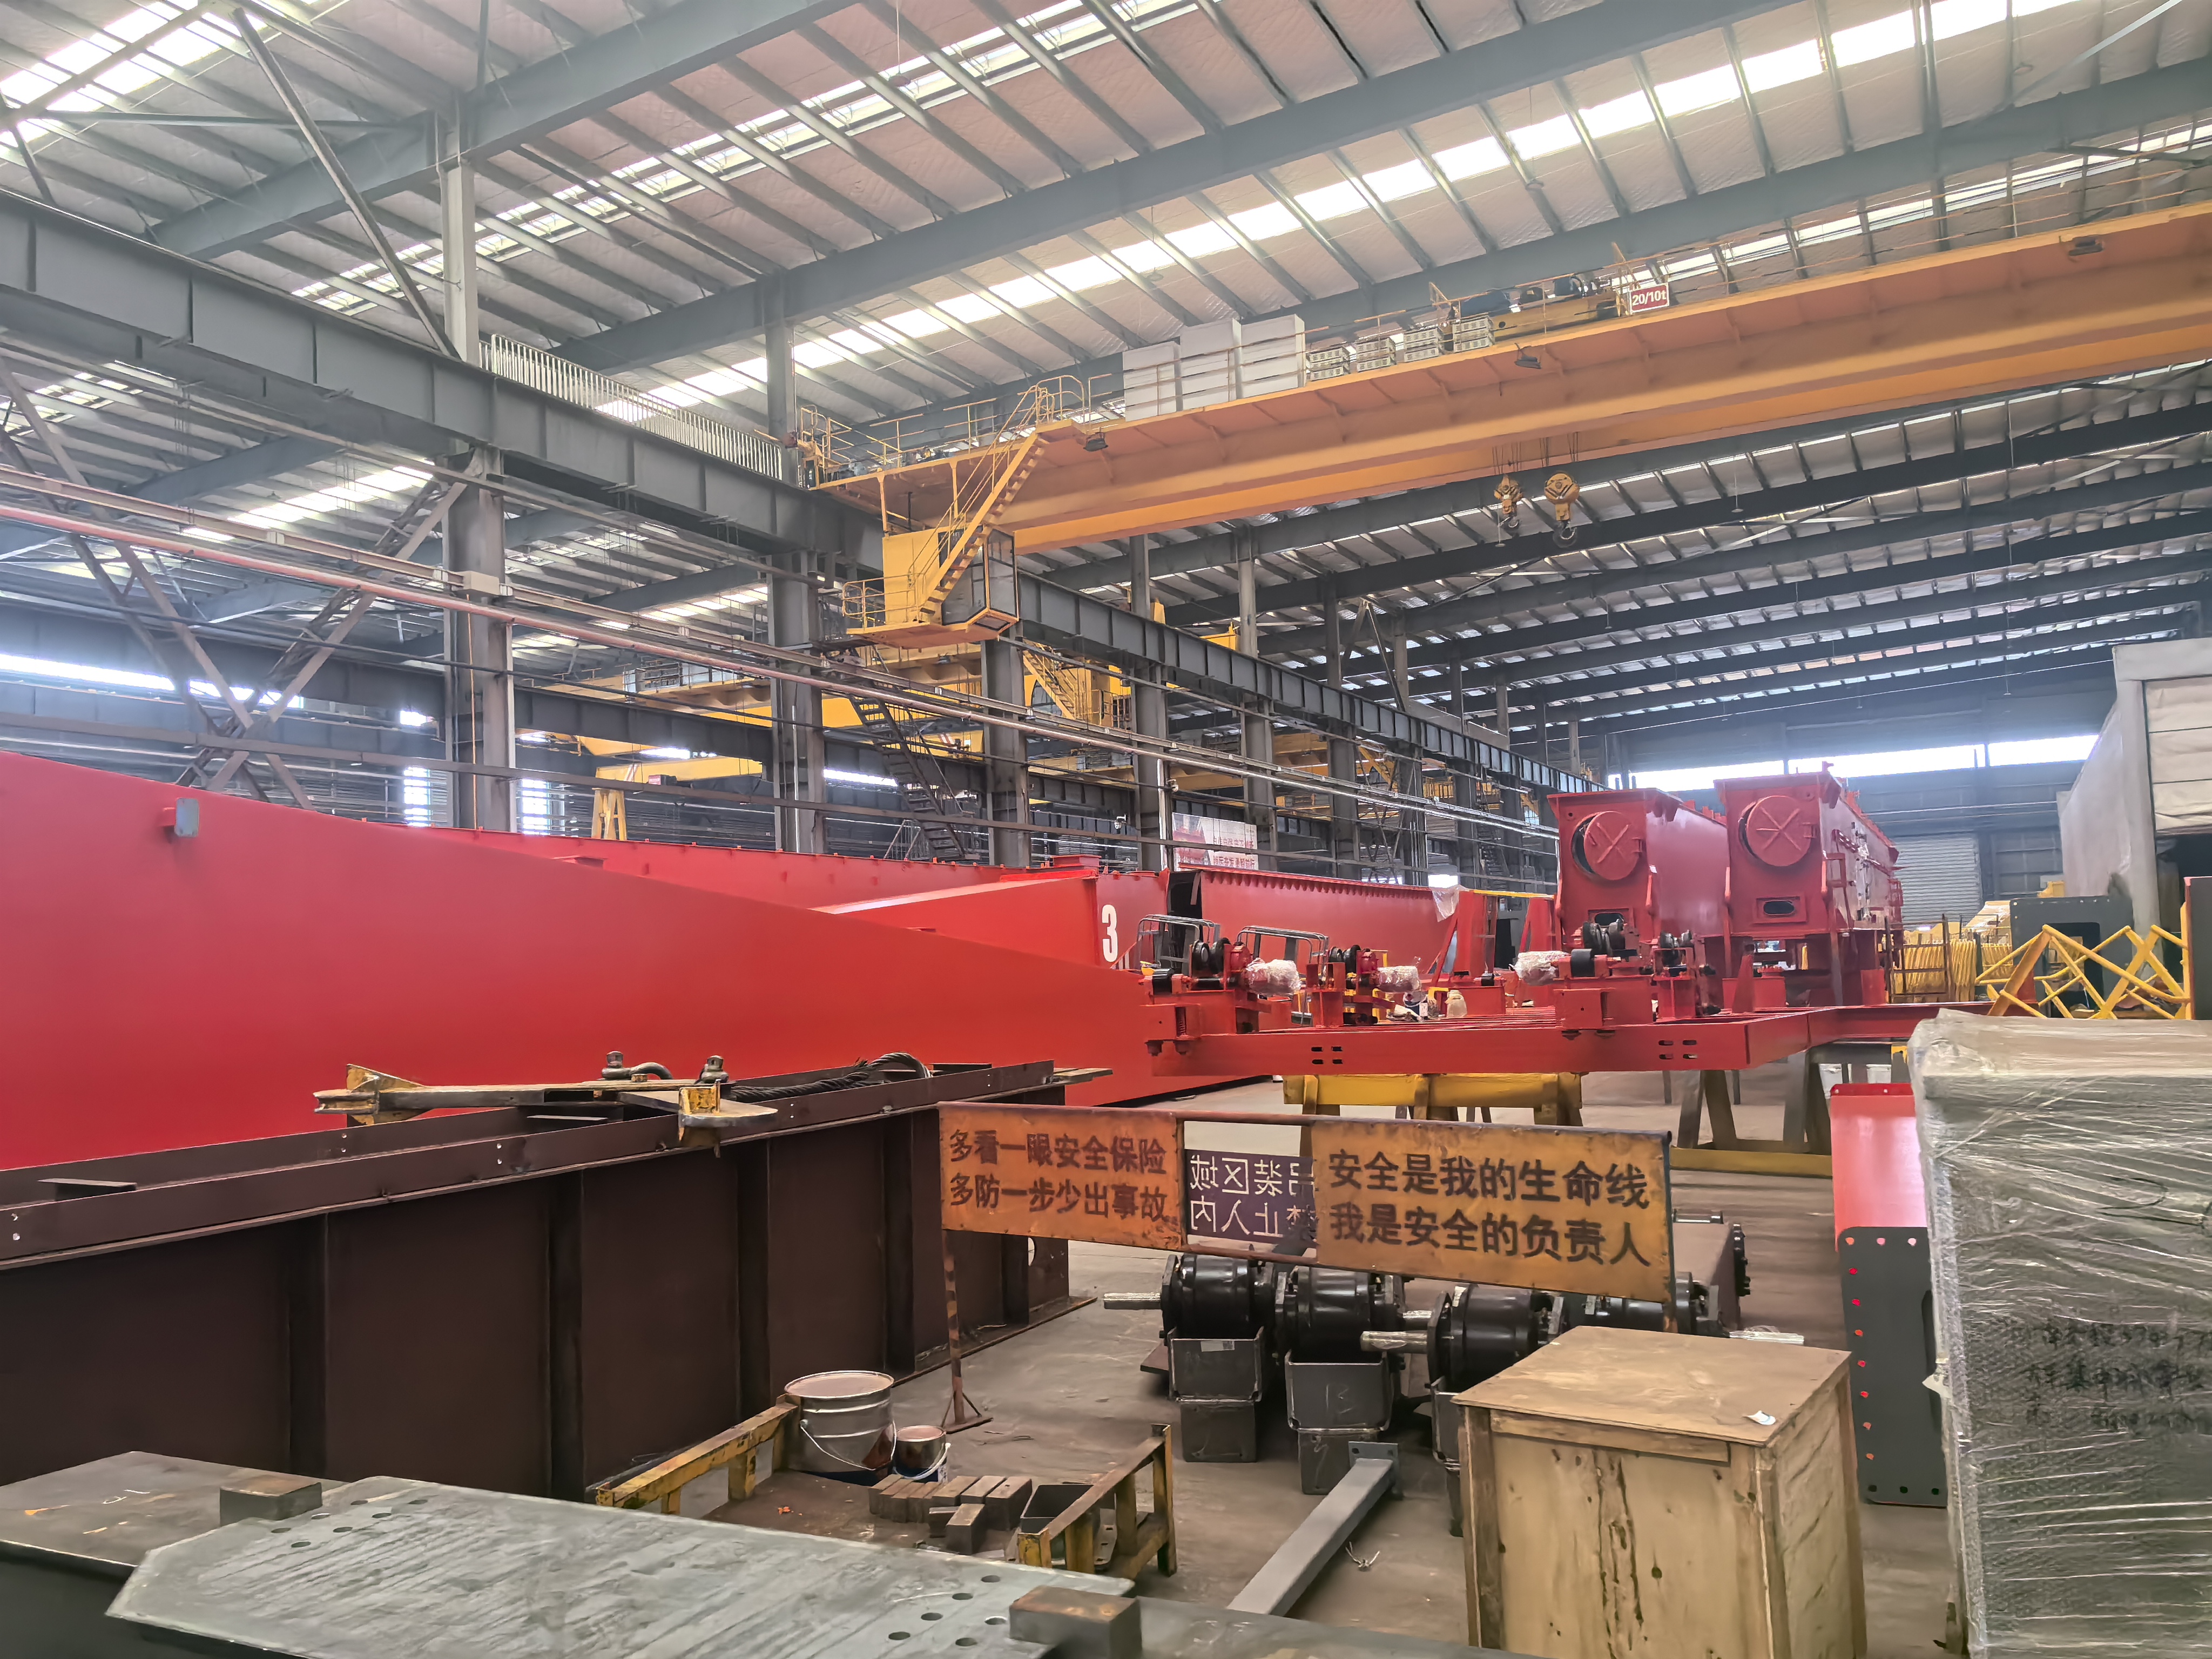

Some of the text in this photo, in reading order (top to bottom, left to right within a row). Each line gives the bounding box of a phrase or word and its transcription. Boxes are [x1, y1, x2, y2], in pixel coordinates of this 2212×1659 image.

[1632, 290, 1667, 306] 20/10t
[1102, 904, 1118, 962] 3
[950, 1129, 1166, 1175] 多看一眼安全保险
[950, 1172, 1167, 1222] 多防一步少出事故
[1328, 1149, 1649, 1210] 安全是我的生命线
[1330, 1202, 1651, 1267] 我是安全的负责人
